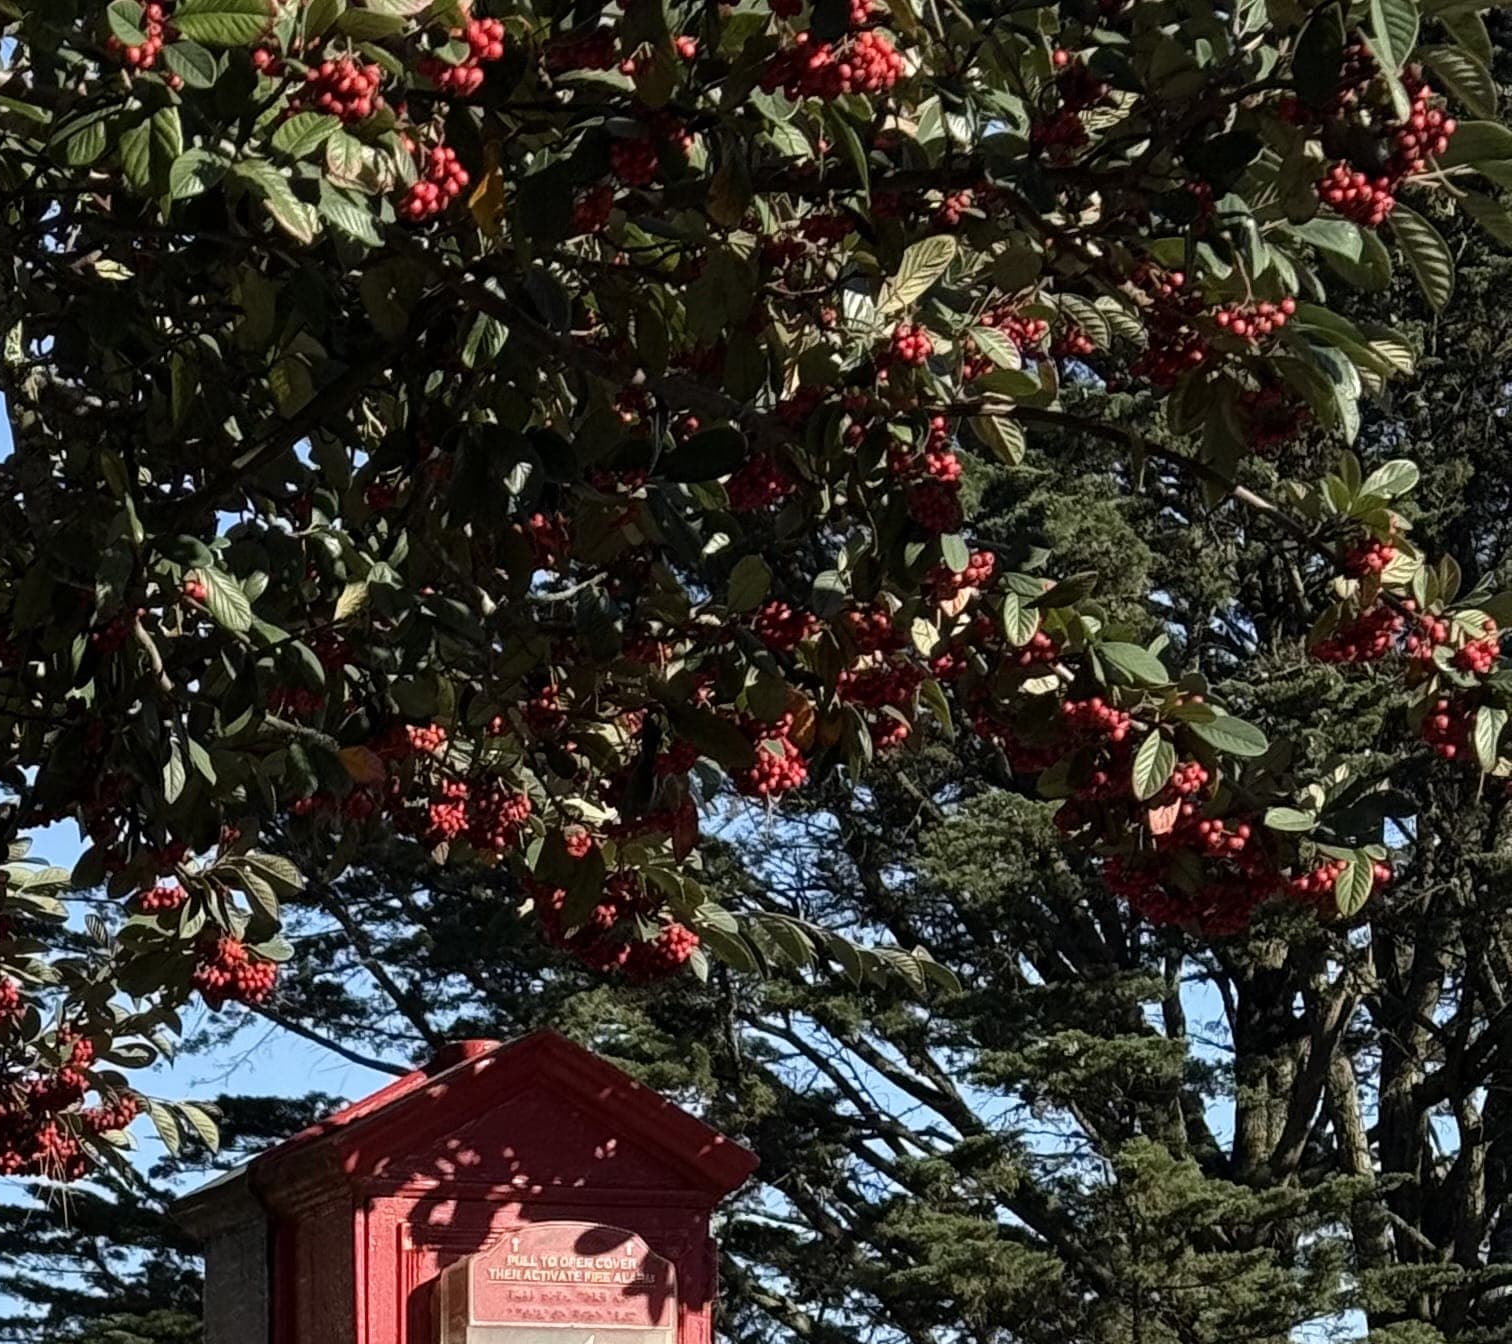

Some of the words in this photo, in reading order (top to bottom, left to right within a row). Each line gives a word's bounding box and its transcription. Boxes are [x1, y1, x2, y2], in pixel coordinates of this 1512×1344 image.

[507, 1255, 537, 1267] PULL
[540, 1255, 557, 1268] TO
[595, 1257, 637, 1270] COVER
[489, 1268, 521, 1281] THEN
[524, 1269, 582, 1281] ACTIVATE
[584, 1271, 611, 1283] FIRE
